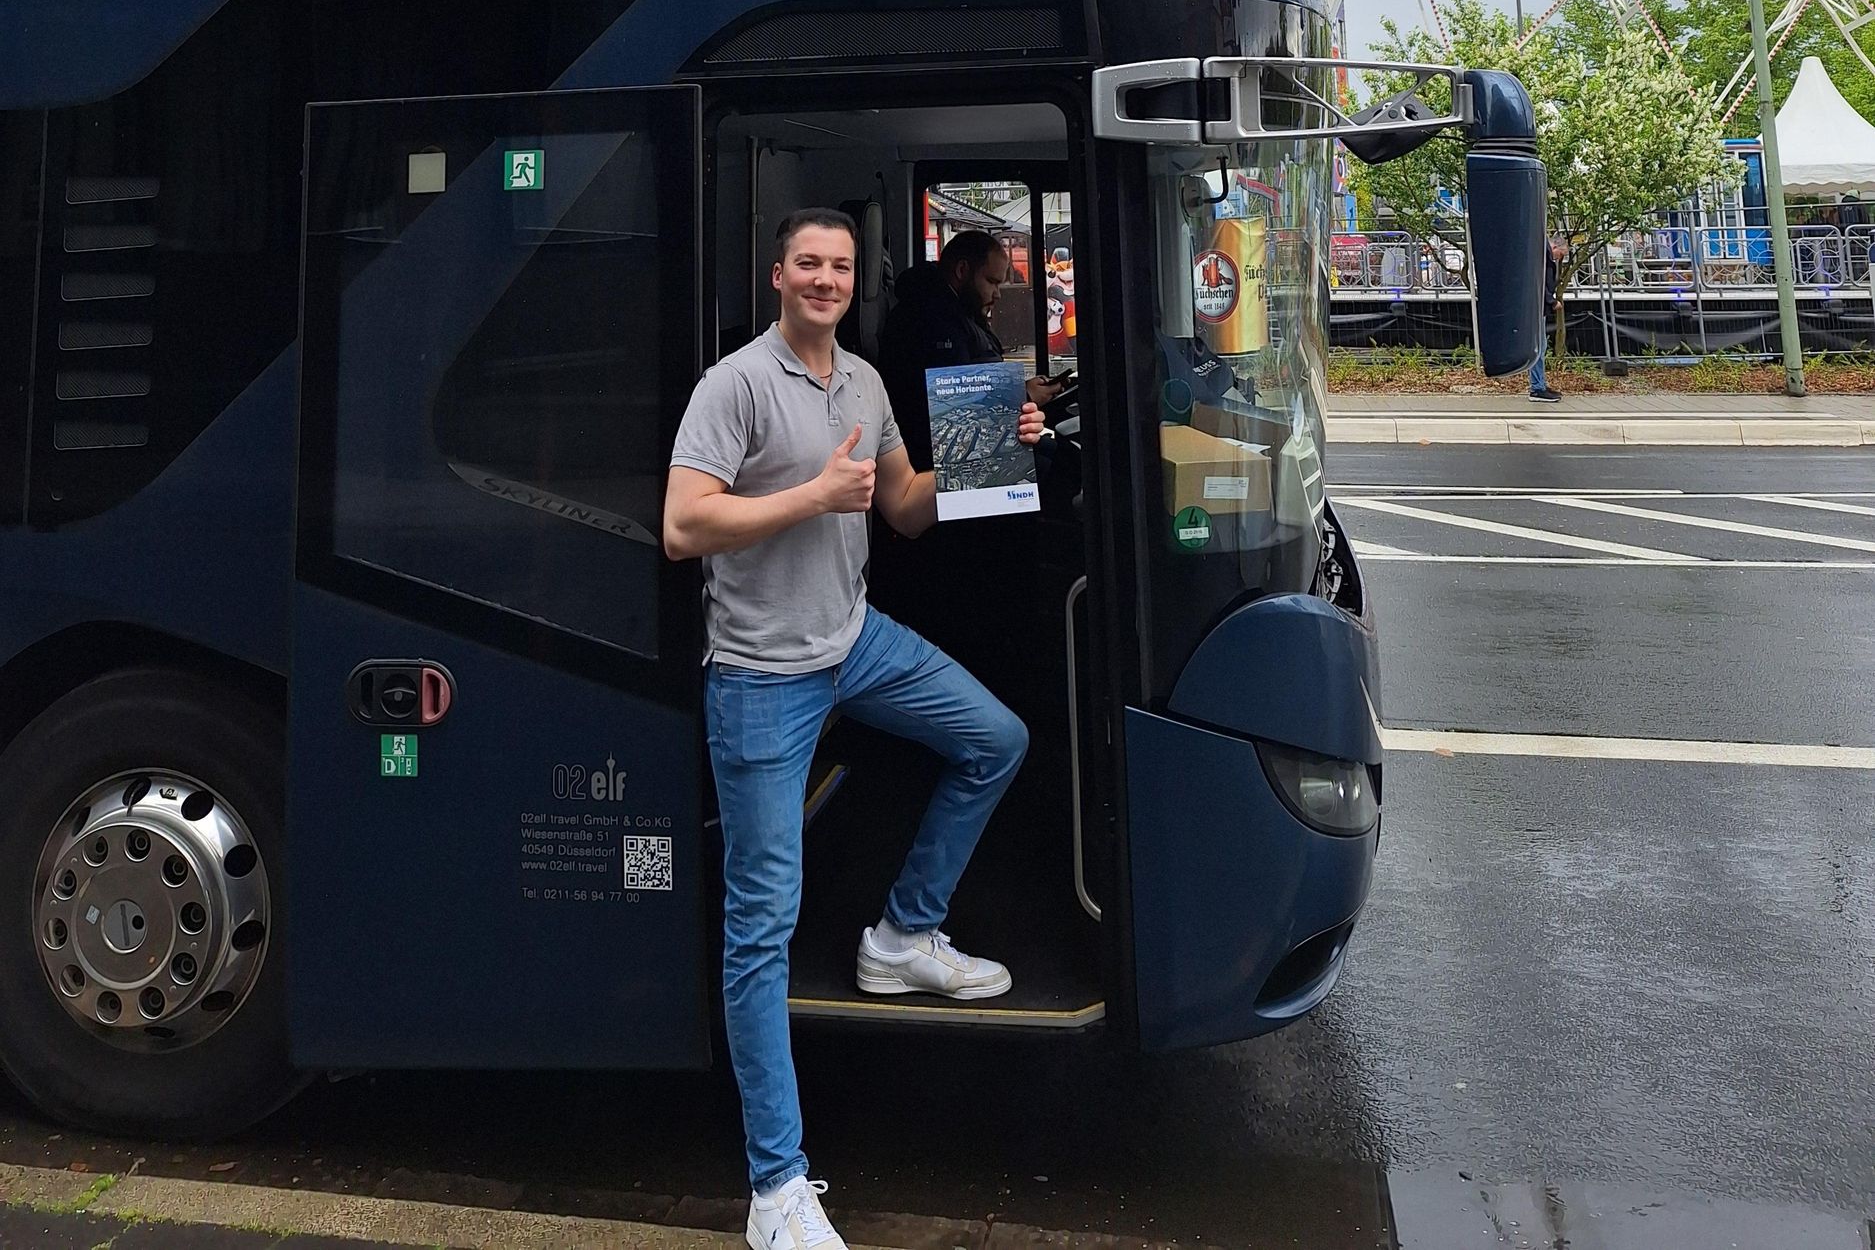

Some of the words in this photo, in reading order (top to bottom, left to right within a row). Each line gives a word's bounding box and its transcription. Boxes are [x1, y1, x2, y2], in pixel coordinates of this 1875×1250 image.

[935, 376, 960, 386] Starke
[961, 374, 992, 385] Partner,
[936, 387, 955, 395] neue
[955, 385, 994, 395] Horizonte.
[478, 477, 633, 535] SKYLINER
[1187, 507, 1199, 527] 4
[520, 813, 546, 824] 02elf
[550, 814, 579, 826] travel
[583, 814, 619, 826] GmbH
[623, 816, 631, 827] &
[520, 828, 593, 841] Wiesenstraße
[597, 831, 609, 841] 51
[521, 844, 554, 856] 40549
[558, 845, 616, 857] Düsseldorf
[521, 861, 608, 873] www.02elf.travel
[591, 890, 604, 901] 94
[609, 891, 622, 902] 77
[626, 892, 640, 903] 00
